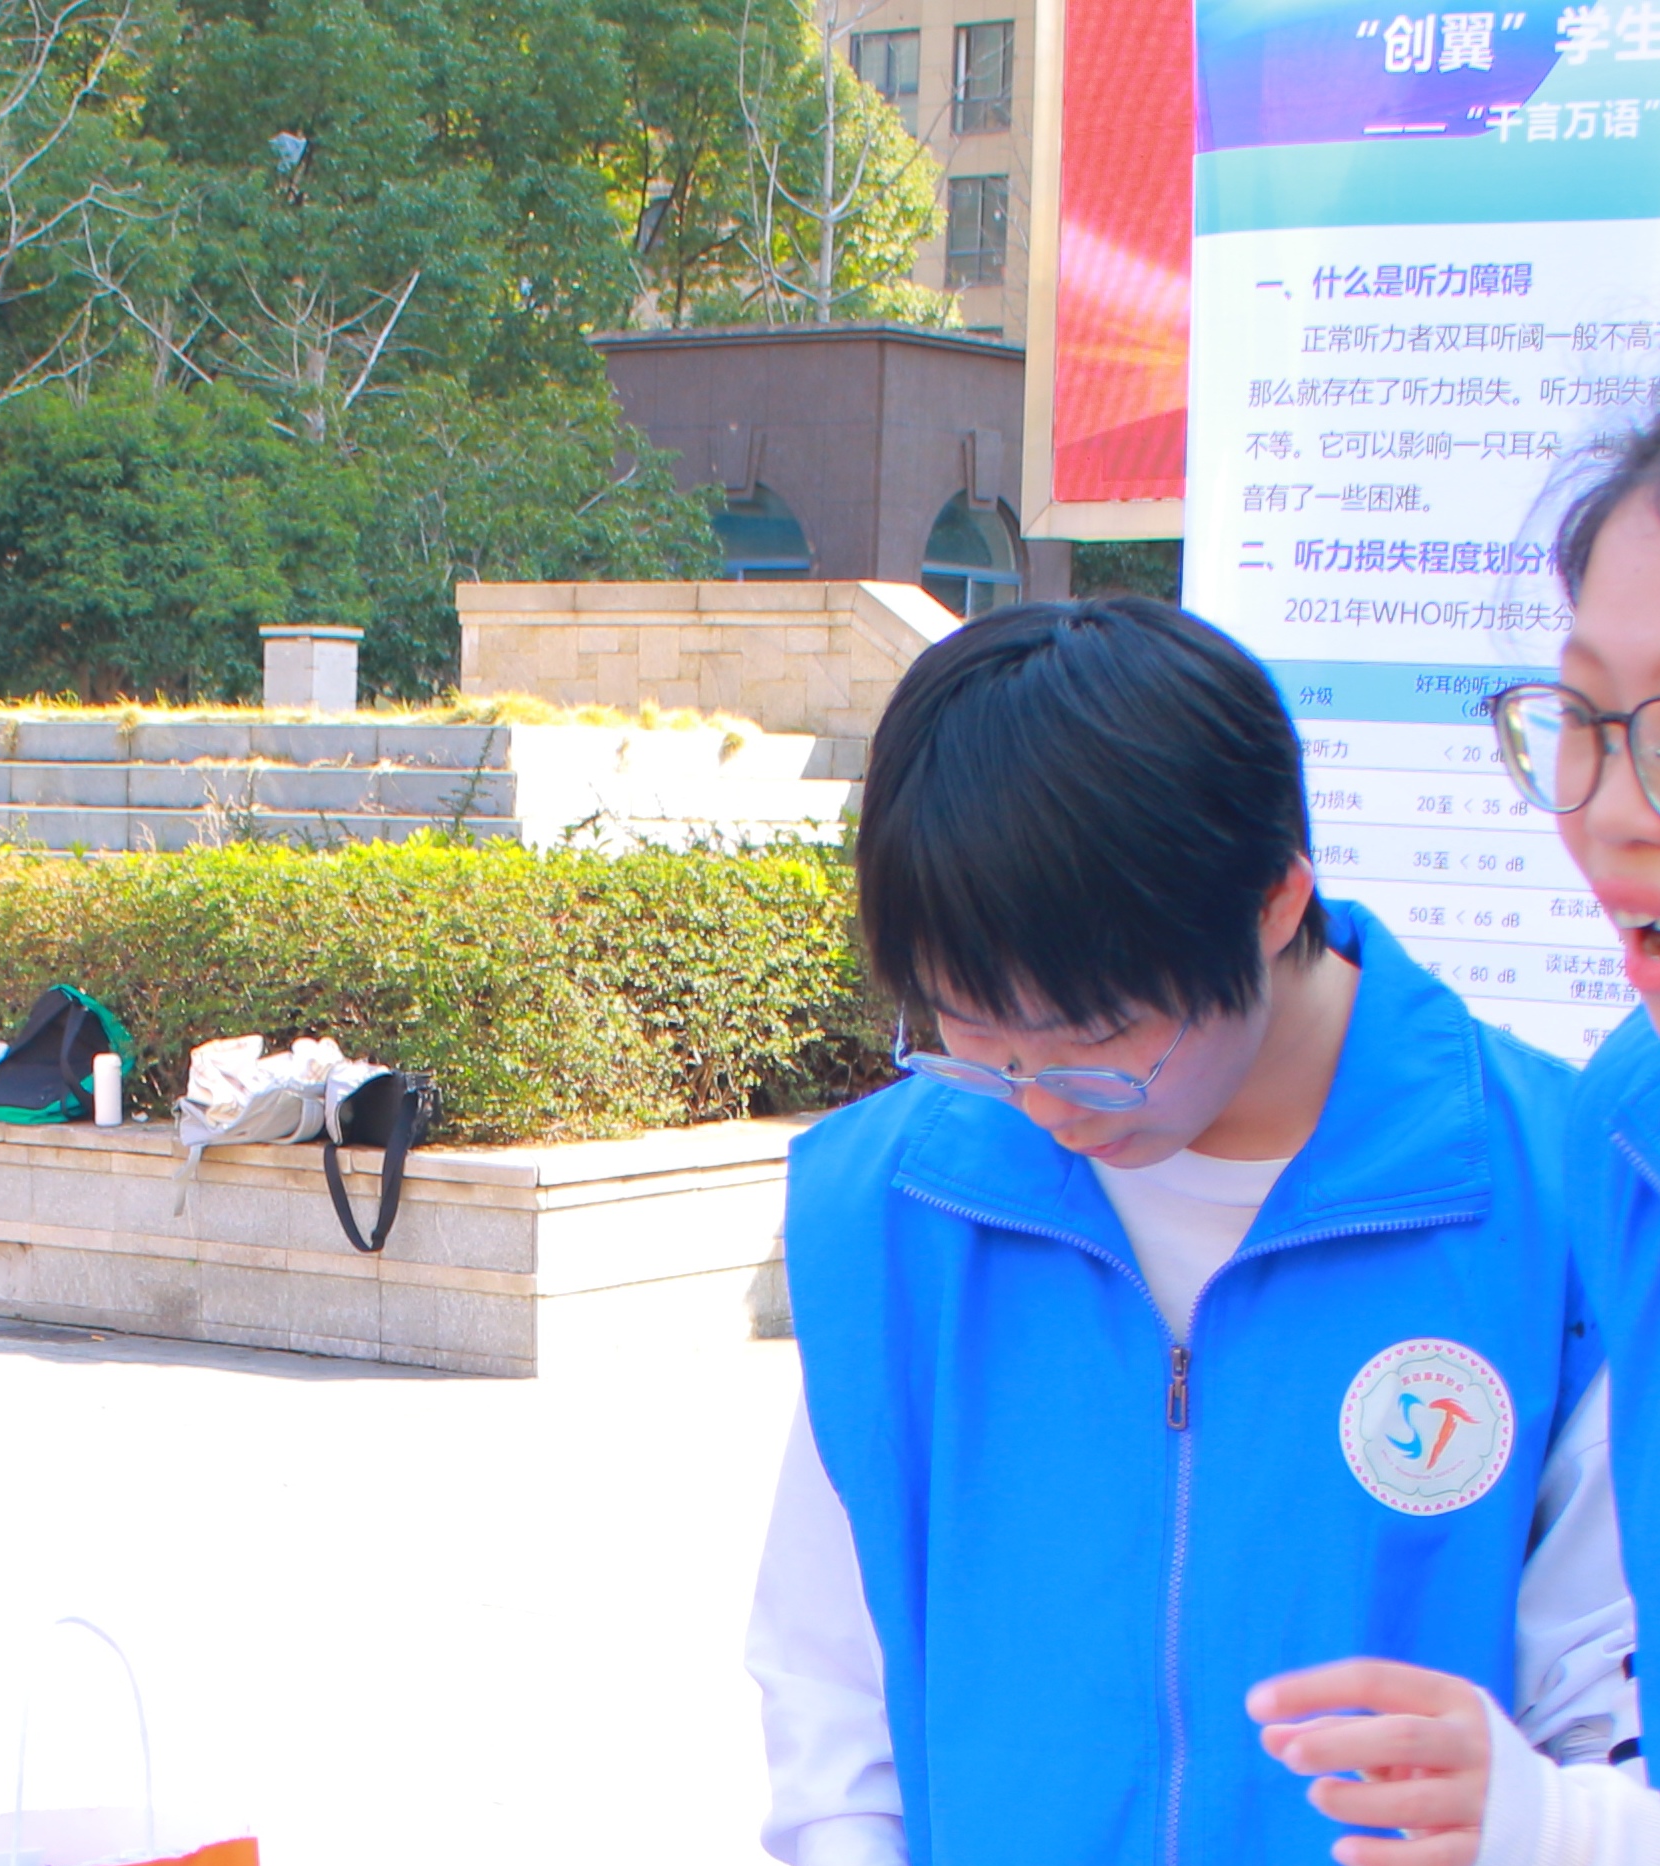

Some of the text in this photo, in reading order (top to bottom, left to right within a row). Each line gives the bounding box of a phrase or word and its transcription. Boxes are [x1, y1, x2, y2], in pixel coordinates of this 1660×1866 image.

[1256, 264, 1533, 300] 一、什么是听力障碍
[1242, 483, 1432, 513] 音有了一些困难。
[1299, 686, 1335, 708] 分级
[1462, 748, 1482, 763] 20
[1482, 799, 1501, 816] 35
[1509, 800, 1529, 817] dB
[1477, 855, 1497, 872] 50
[1505, 855, 1525, 873] dB
[1473, 911, 1493, 928] 65
[1501, 912, 1521, 929] dB
[1470, 966, 1489, 983] 80
[1497, 969, 1517, 984] dB
